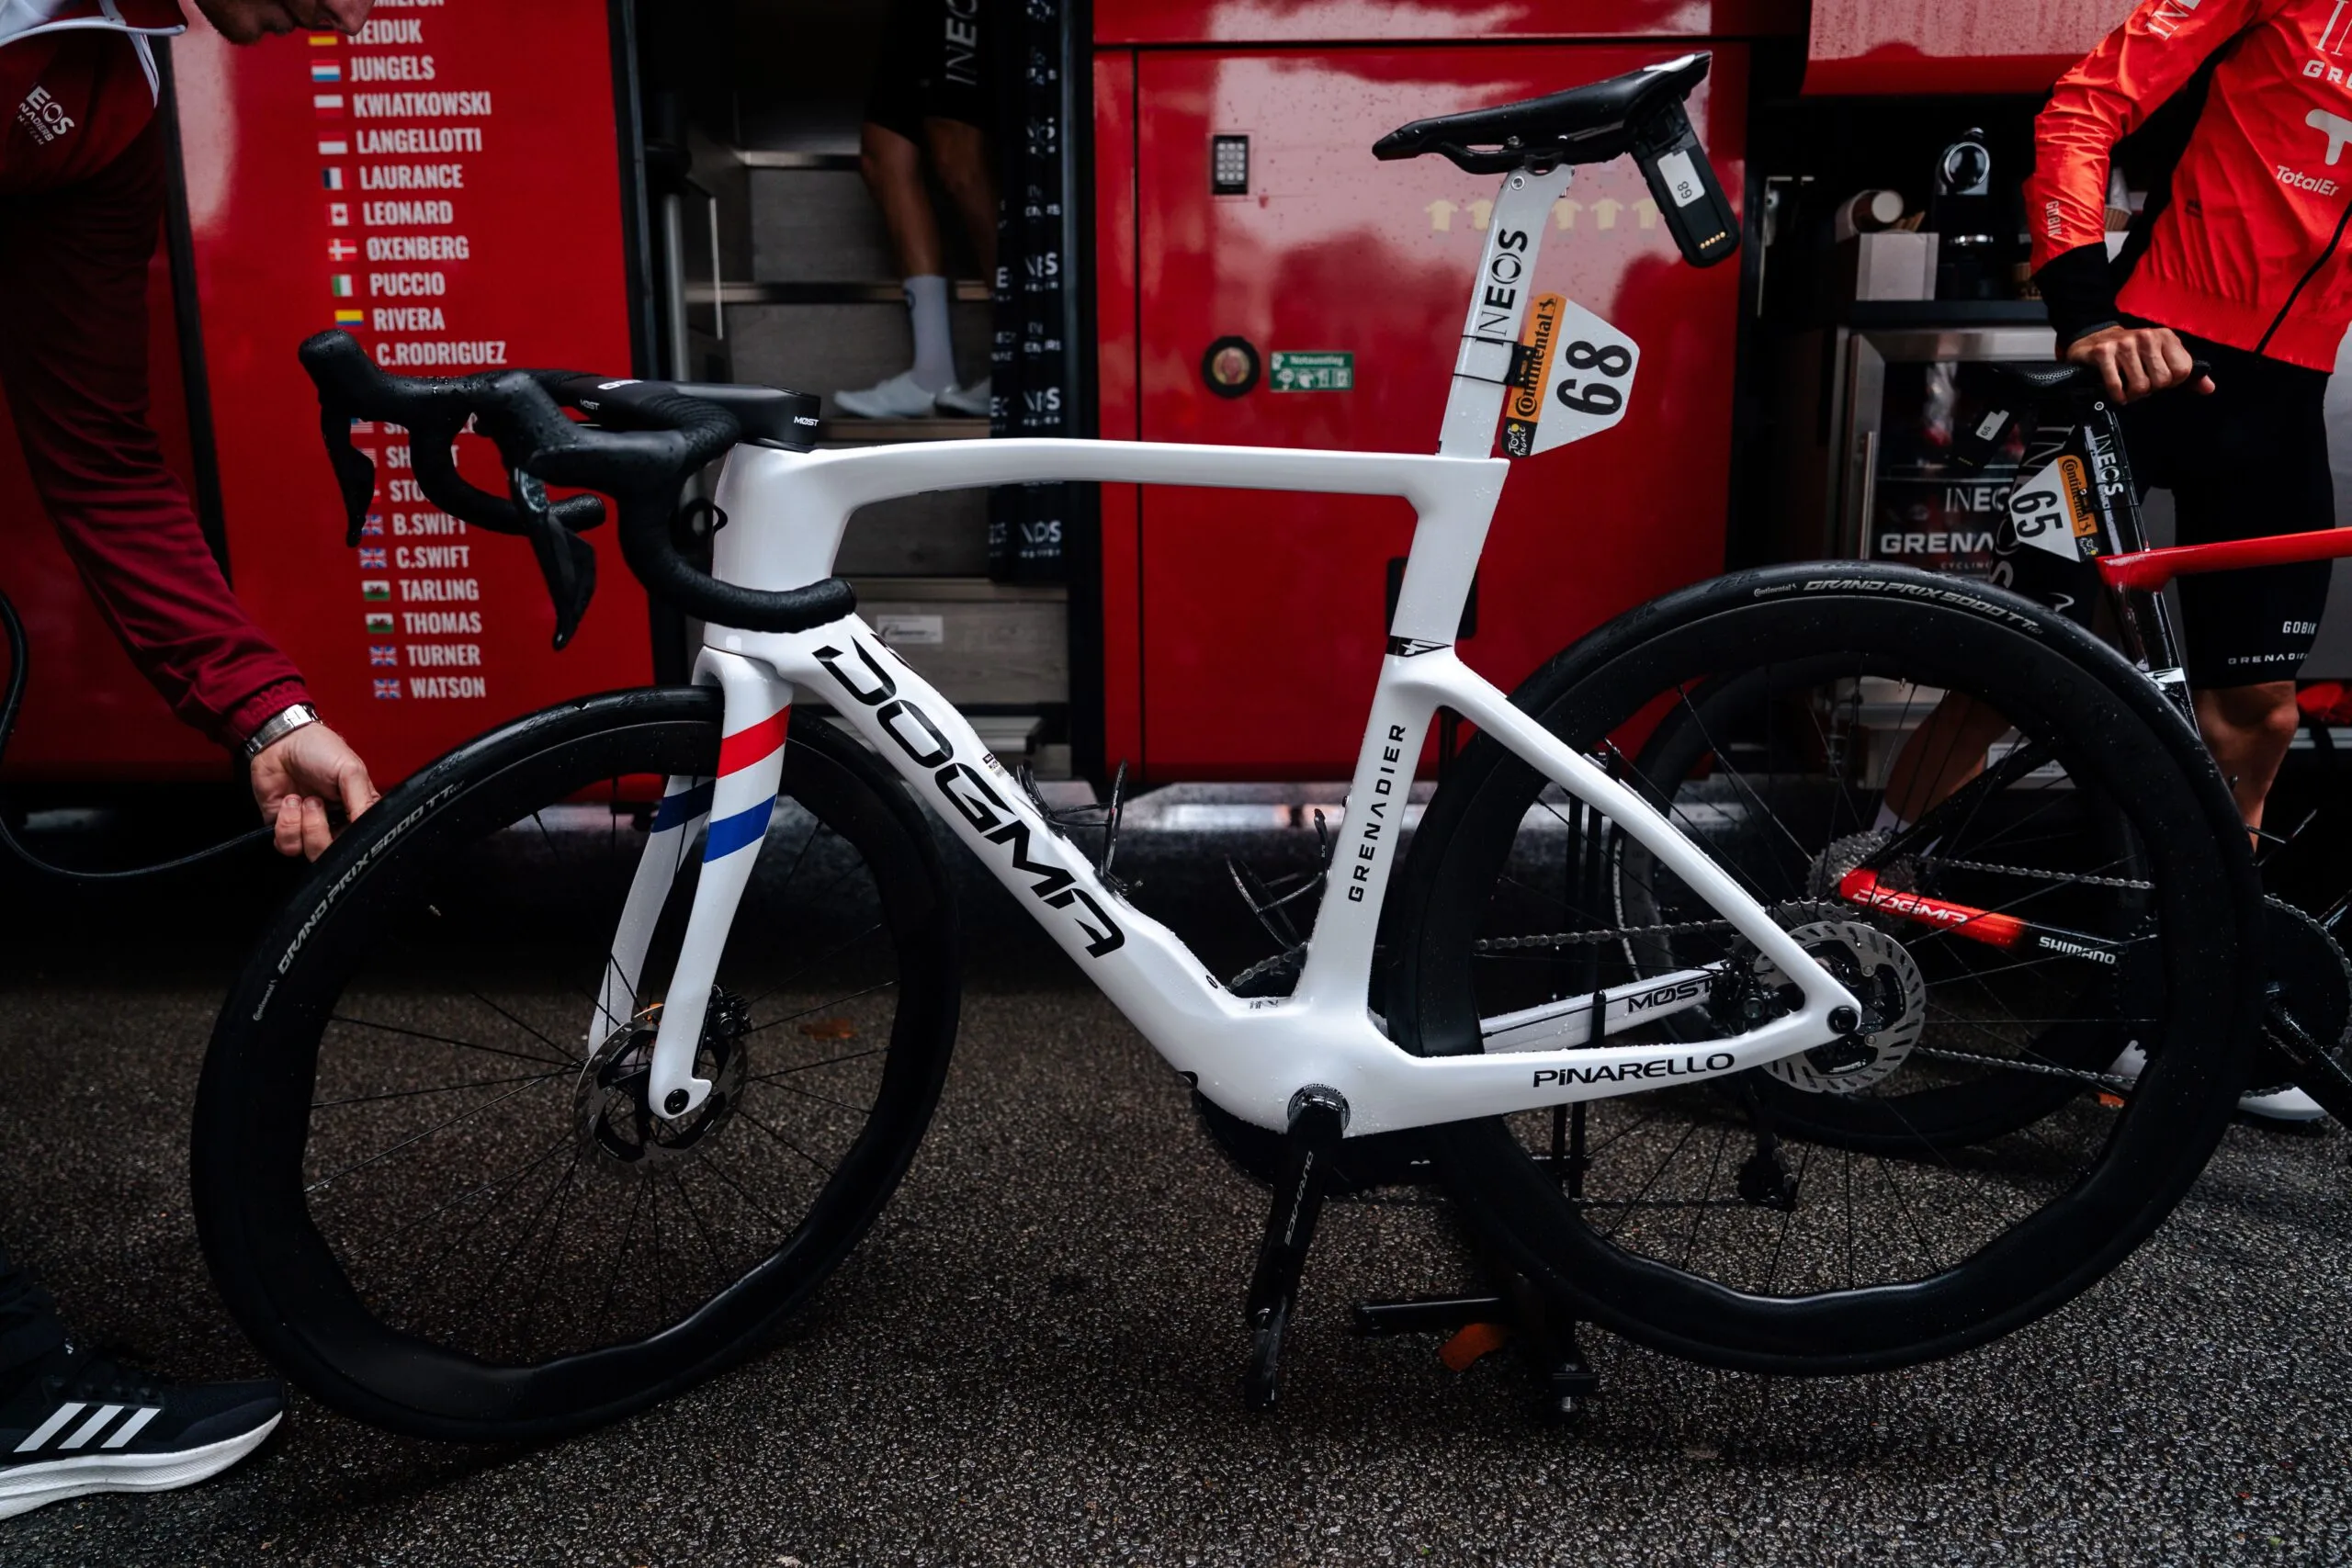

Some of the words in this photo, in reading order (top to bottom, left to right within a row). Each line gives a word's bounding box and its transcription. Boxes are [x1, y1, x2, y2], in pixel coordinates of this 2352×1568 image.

[350, 55, 435, 83] JUNGELS
[352, 91, 492, 118] KWIATKOWSKI
[18, 102, 55, 142] NADIERS
[356, 128, 483, 154] LANGELLOTTI
[359, 164, 464, 191] LAURANCE
[1677, 181, 1692, 199] 68
[363, 200, 454, 226] LEONARD
[369, 271, 447, 298] PUCCIO
[1475, 228, 1529, 348] INEOS
[372, 307, 447, 333] RIVERA
[376, 341, 508, 367] C.RODRIGUEZ
[1515, 310, 1555, 417] Continental
[1556, 340, 1633, 416] 68
[1981, 425, 1992, 436] 65
[2092, 434, 2124, 496] INEOS
[392, 513, 467, 536] B.SWIFT
[2011, 490, 2064, 538] 65
[1881, 532, 1995, 554] GRENA
[395, 546, 470, 570] C.SWIFT
[399, 579, 480, 603] TARLING
[1753, 583, 1792, 598] Continental
[1804, 580, 1885, 592] GRAND
[1883, 582, 1944, 599] PRIX
[1939, 591, 2008, 617] 5000
[402, 611, 483, 635] THOMAS
[406, 644, 481, 667] TURNER
[410, 676, 486, 700] WATSON
[811, 636, 1125, 959] DOGMA
[1348, 724, 1407, 903] GRENADIER
[277, 899, 329, 975] GRAND
[327, 852, 369, 904] PRIX
[370, 805, 424, 858] 5000
[1852, 888, 1968, 924] DOGMA
[2039, 935, 2116, 965] SHIMANO
